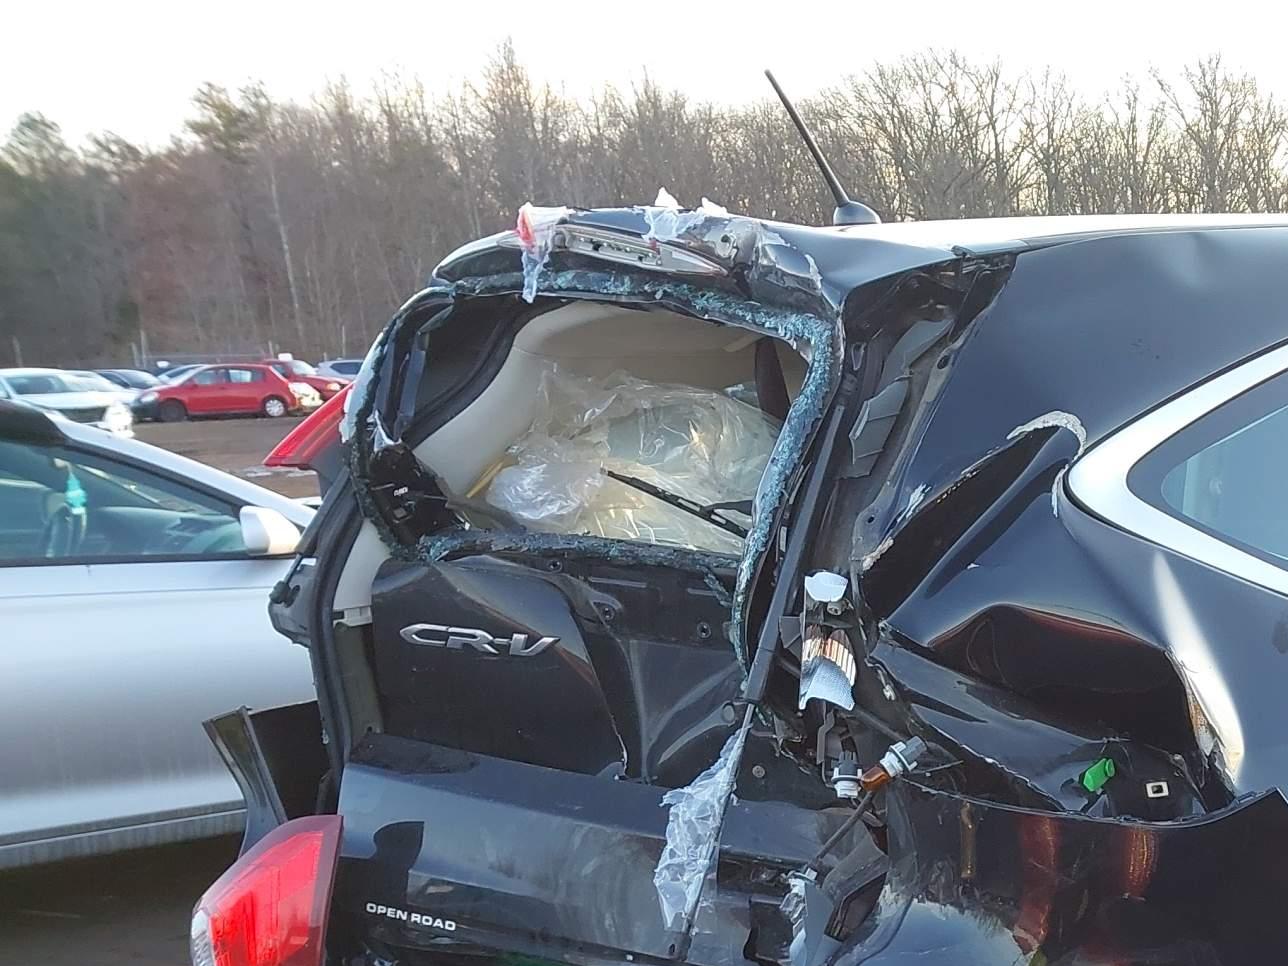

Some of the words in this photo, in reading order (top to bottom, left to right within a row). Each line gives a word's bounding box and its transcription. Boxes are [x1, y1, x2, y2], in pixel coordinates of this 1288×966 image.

[400, 623, 561, 657] CR-V
[366, 902, 408, 921] OPEN
[411, 912, 456, 931] ROAD
